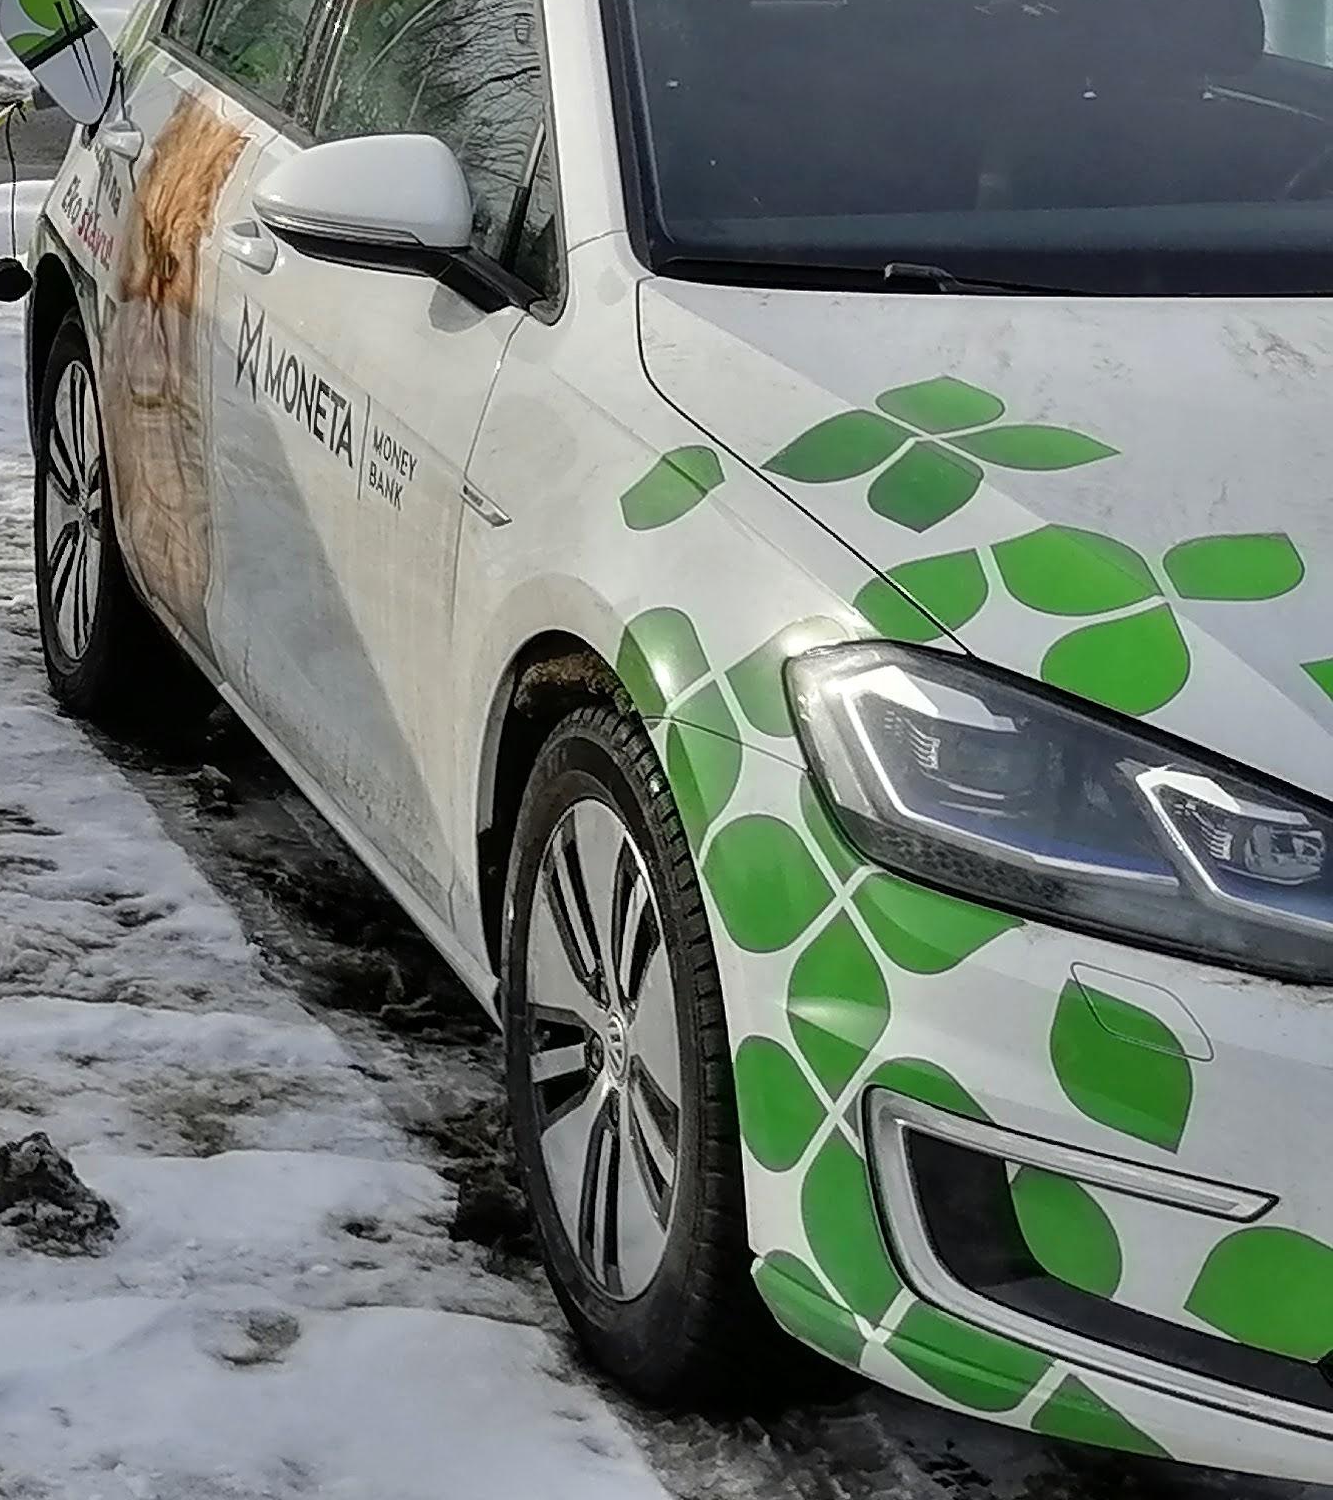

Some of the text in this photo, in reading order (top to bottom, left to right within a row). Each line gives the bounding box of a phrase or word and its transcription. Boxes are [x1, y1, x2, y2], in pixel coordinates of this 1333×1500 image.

[264, 336, 353, 468] MONETA
[373, 426, 418, 481] MONEY
[369, 461, 403, 510] BANK
